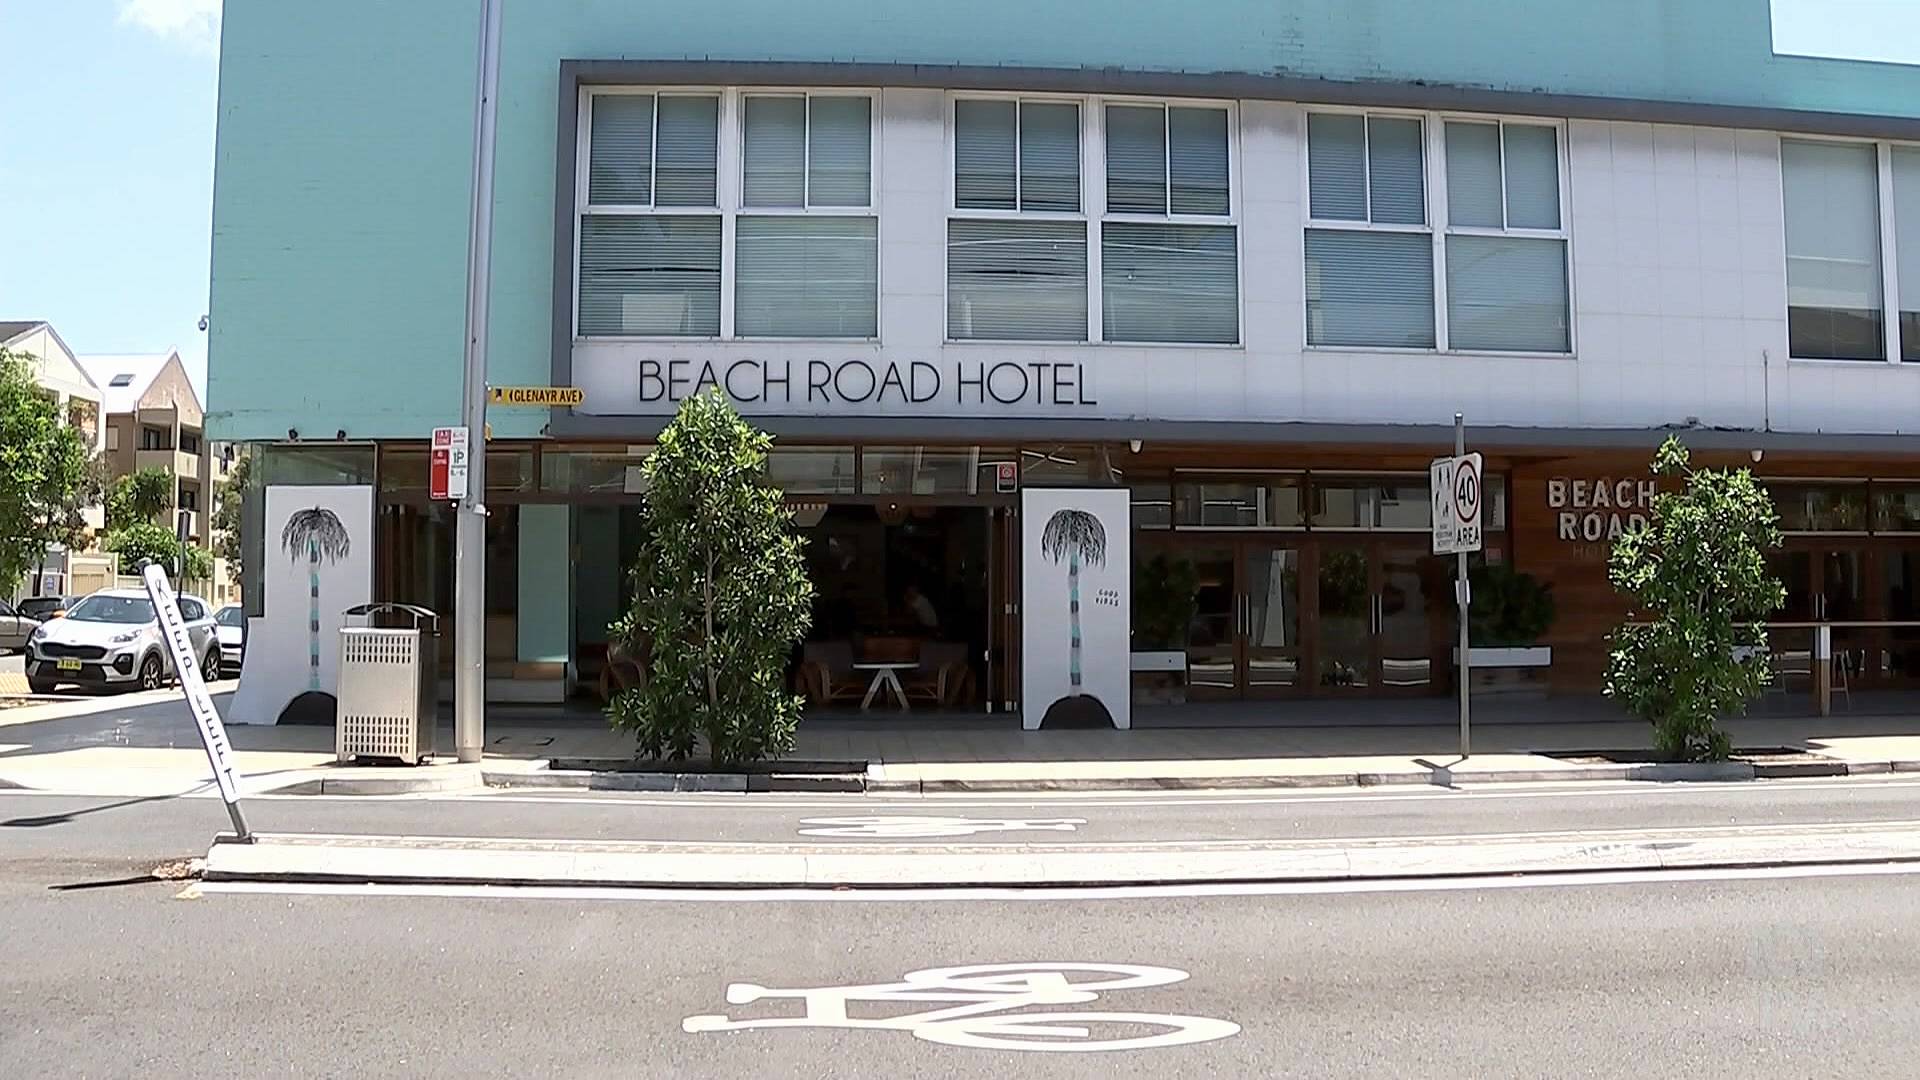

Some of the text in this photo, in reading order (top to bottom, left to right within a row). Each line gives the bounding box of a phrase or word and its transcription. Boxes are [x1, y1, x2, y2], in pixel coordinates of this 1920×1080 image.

[513, 388, 578, 404] GLENAYR AVE
[638, 359, 1098, 406] BEACH ROAD HOTEL
[1457, 475, 1476, 507] 40
[1548, 479, 1656, 509] BEACH
[1456, 526, 1481, 547] AREA
[1559, 512, 1647, 542] ROAD
[154, 578, 238, 795] KEEP LEFT
